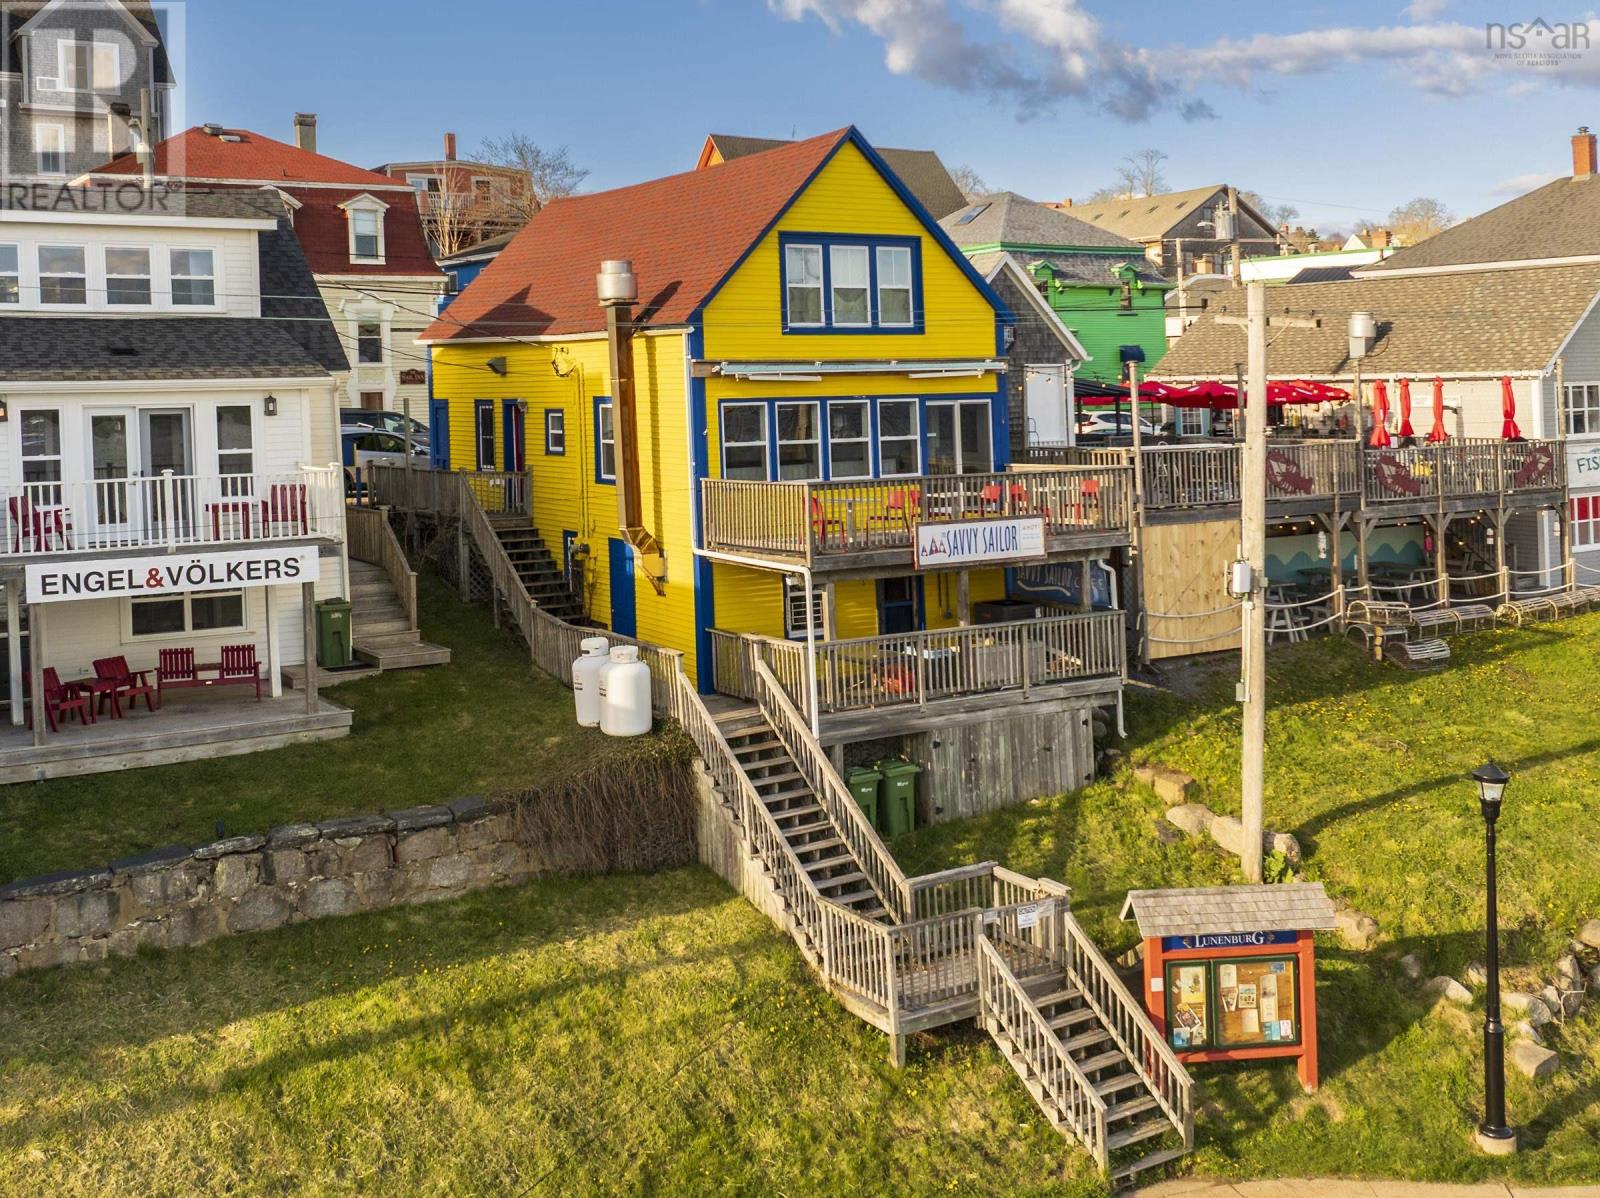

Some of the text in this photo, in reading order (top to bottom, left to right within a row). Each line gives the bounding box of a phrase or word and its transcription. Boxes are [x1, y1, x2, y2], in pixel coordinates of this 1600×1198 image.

[946, 525, 1018, 557] SAVVY SAILOR
[1044, 566, 1073, 588] SAILOR
